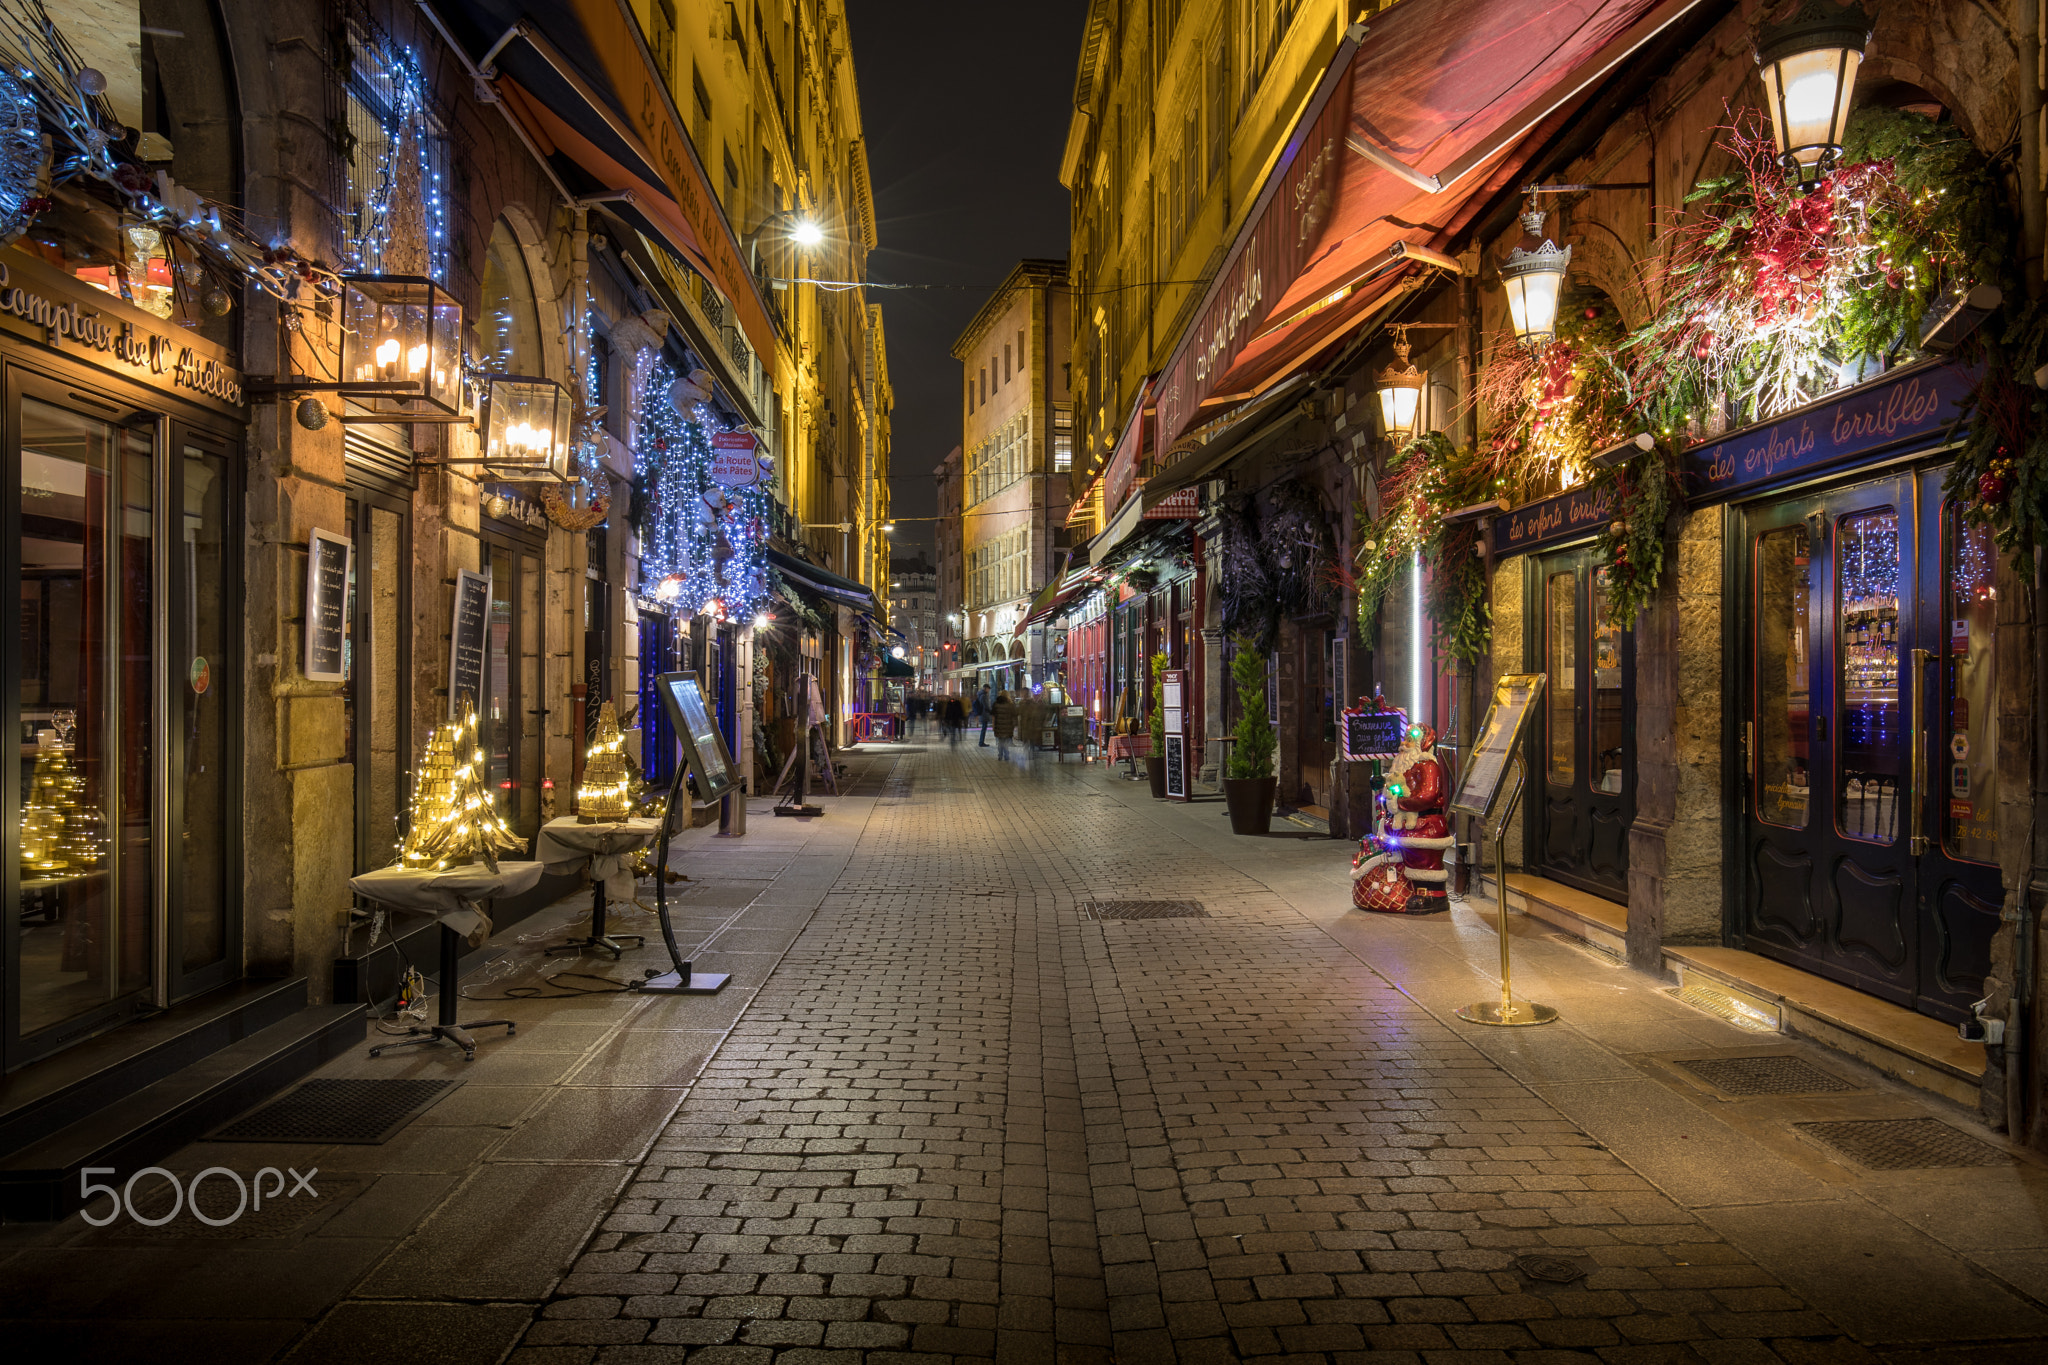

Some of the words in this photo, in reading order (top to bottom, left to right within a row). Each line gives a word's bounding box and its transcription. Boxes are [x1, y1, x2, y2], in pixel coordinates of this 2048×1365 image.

[661, 120, 700, 228] Comptoir
[703, 208, 712, 245] de
[721, 246, 741, 304] Atelier
[122, 322, 150, 367] de
[180, 347, 245, 408] Atelier
[1709, 445, 1736, 482] Les
[1744, 419, 1815, 476] enfants
[1831, 377, 1939, 446] terribles
[712, 465, 728, 475] des
[730, 466, 753, 476] Pâtes
[714, 456, 724, 464] La
[727, 456, 752, 466] Route
[1509, 515, 1524, 540] Les
[1528, 503, 1563, 539] enfants
